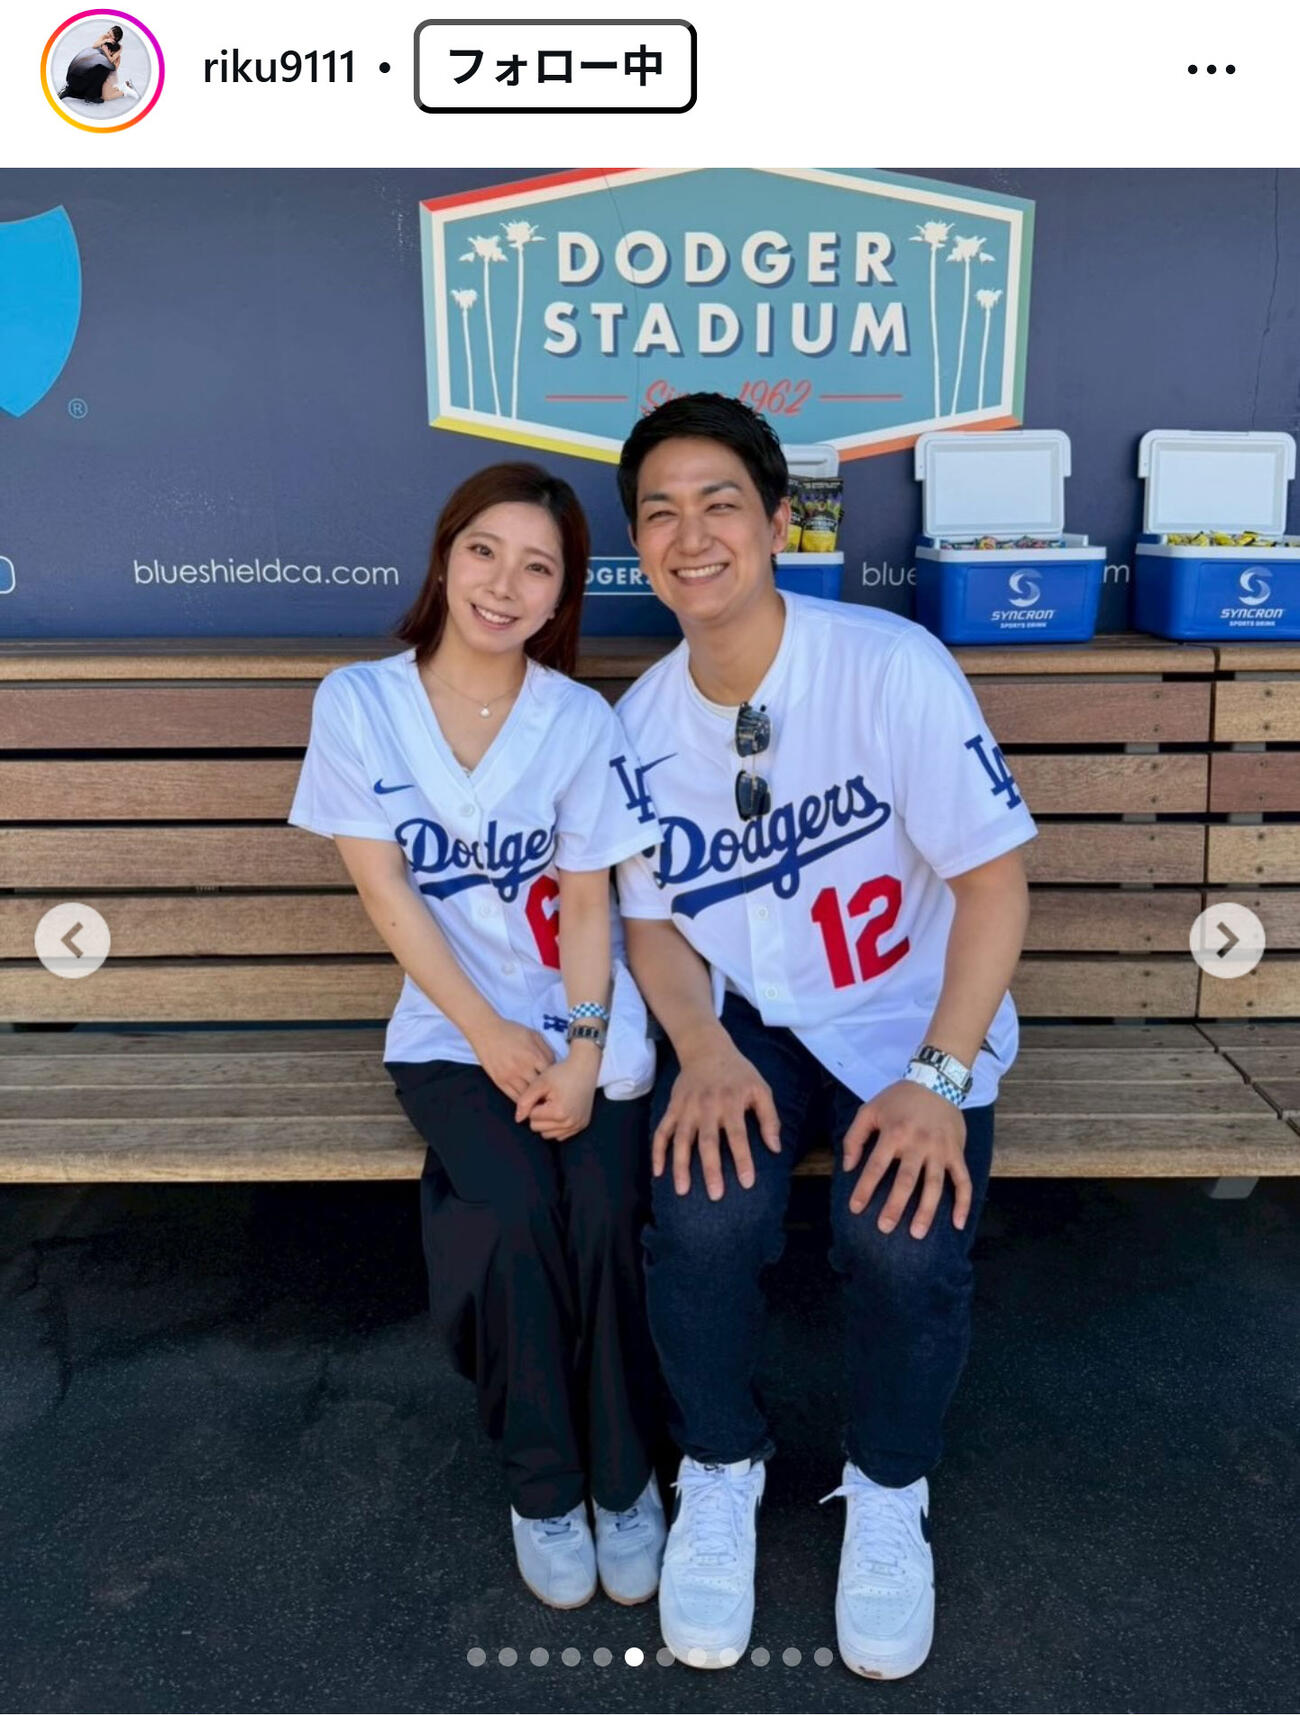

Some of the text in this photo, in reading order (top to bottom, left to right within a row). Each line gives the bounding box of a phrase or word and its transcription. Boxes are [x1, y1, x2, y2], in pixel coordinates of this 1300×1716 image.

[557, 230, 899, 286] DODGER
[543, 301, 911, 357] STADIUM
[133, 557, 400, 585] blueshieldca.com
[990, 609, 1055, 621] SYNCRON
[1220, 608, 1284, 619] SYNCRON
[641, 775, 891, 919] Dodgers
[811, 874, 910, 989] 12
